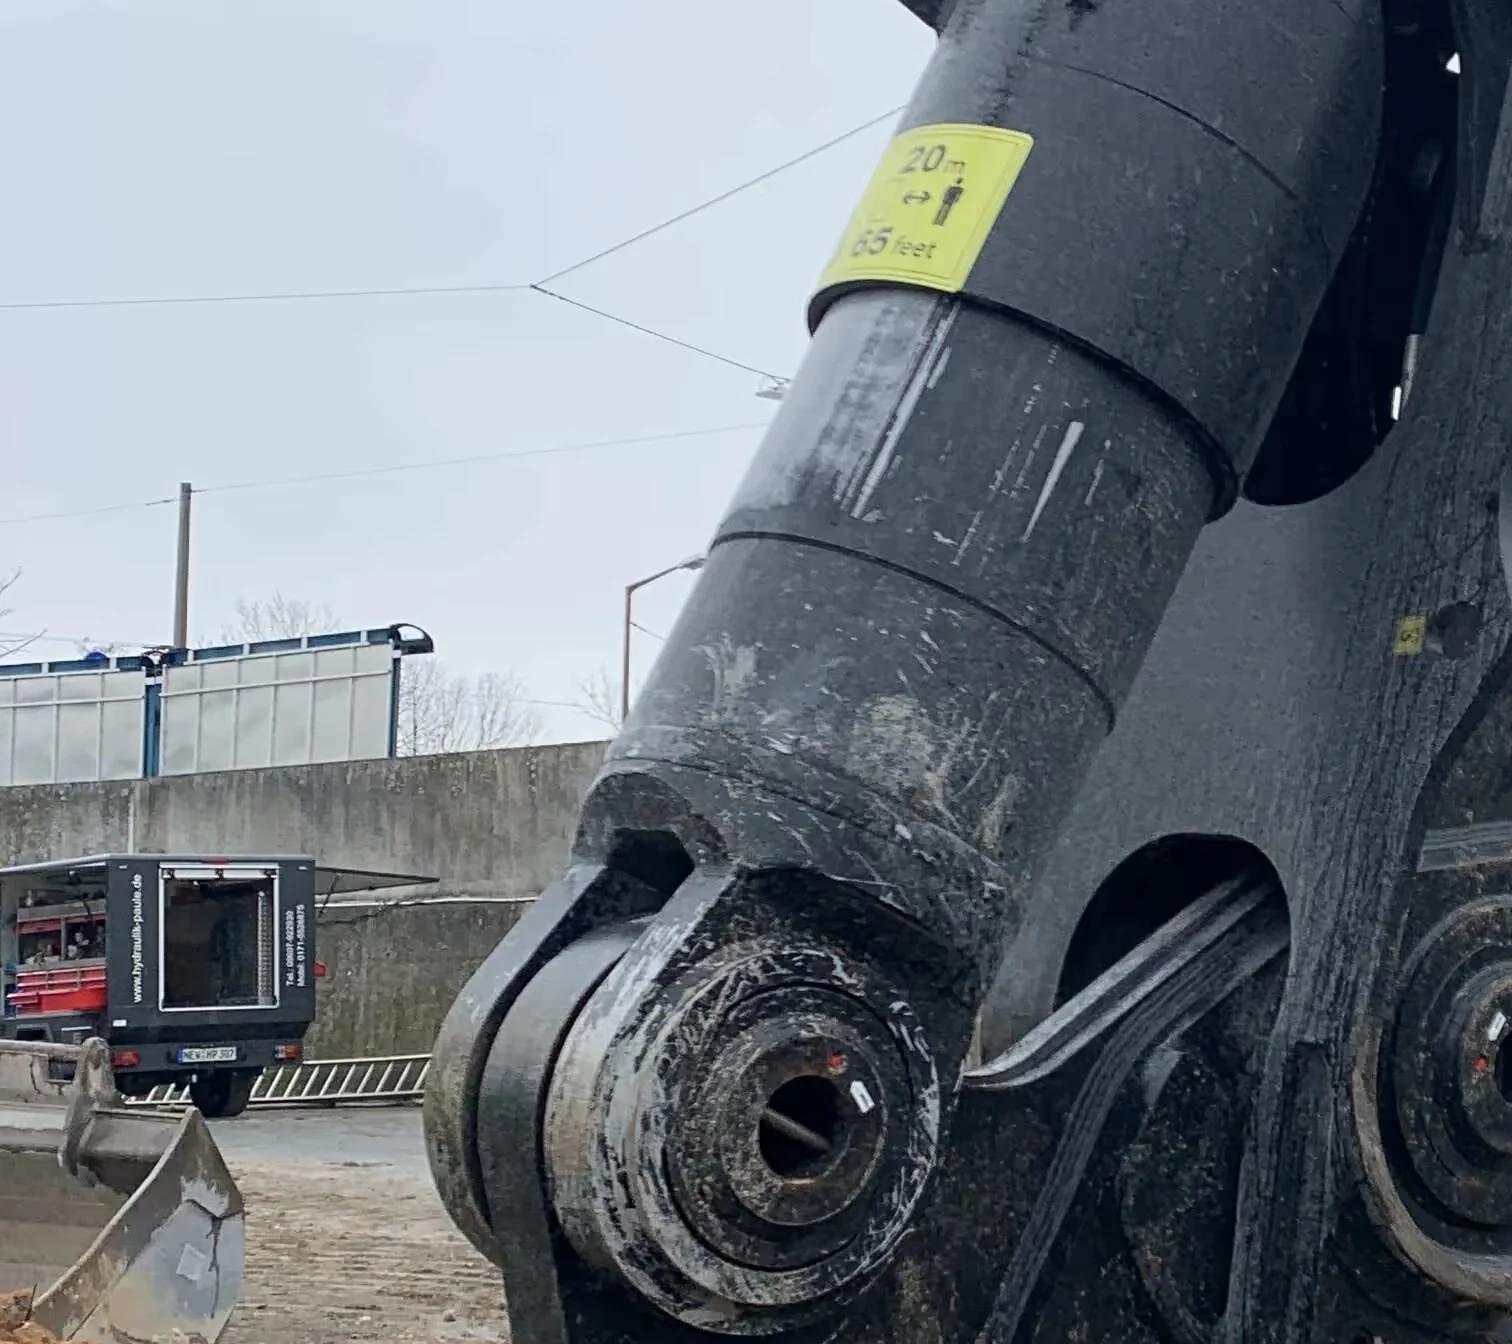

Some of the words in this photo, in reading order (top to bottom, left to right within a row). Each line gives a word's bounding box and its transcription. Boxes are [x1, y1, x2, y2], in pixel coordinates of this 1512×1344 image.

[899, 144, 947, 175] 20
[943, 159, 966, 175] m
[851, 226, 894, 257] 65
[893, 234, 937, 259] feet
[131, 873, 144, 1005] www.hydraulik-paule.de
